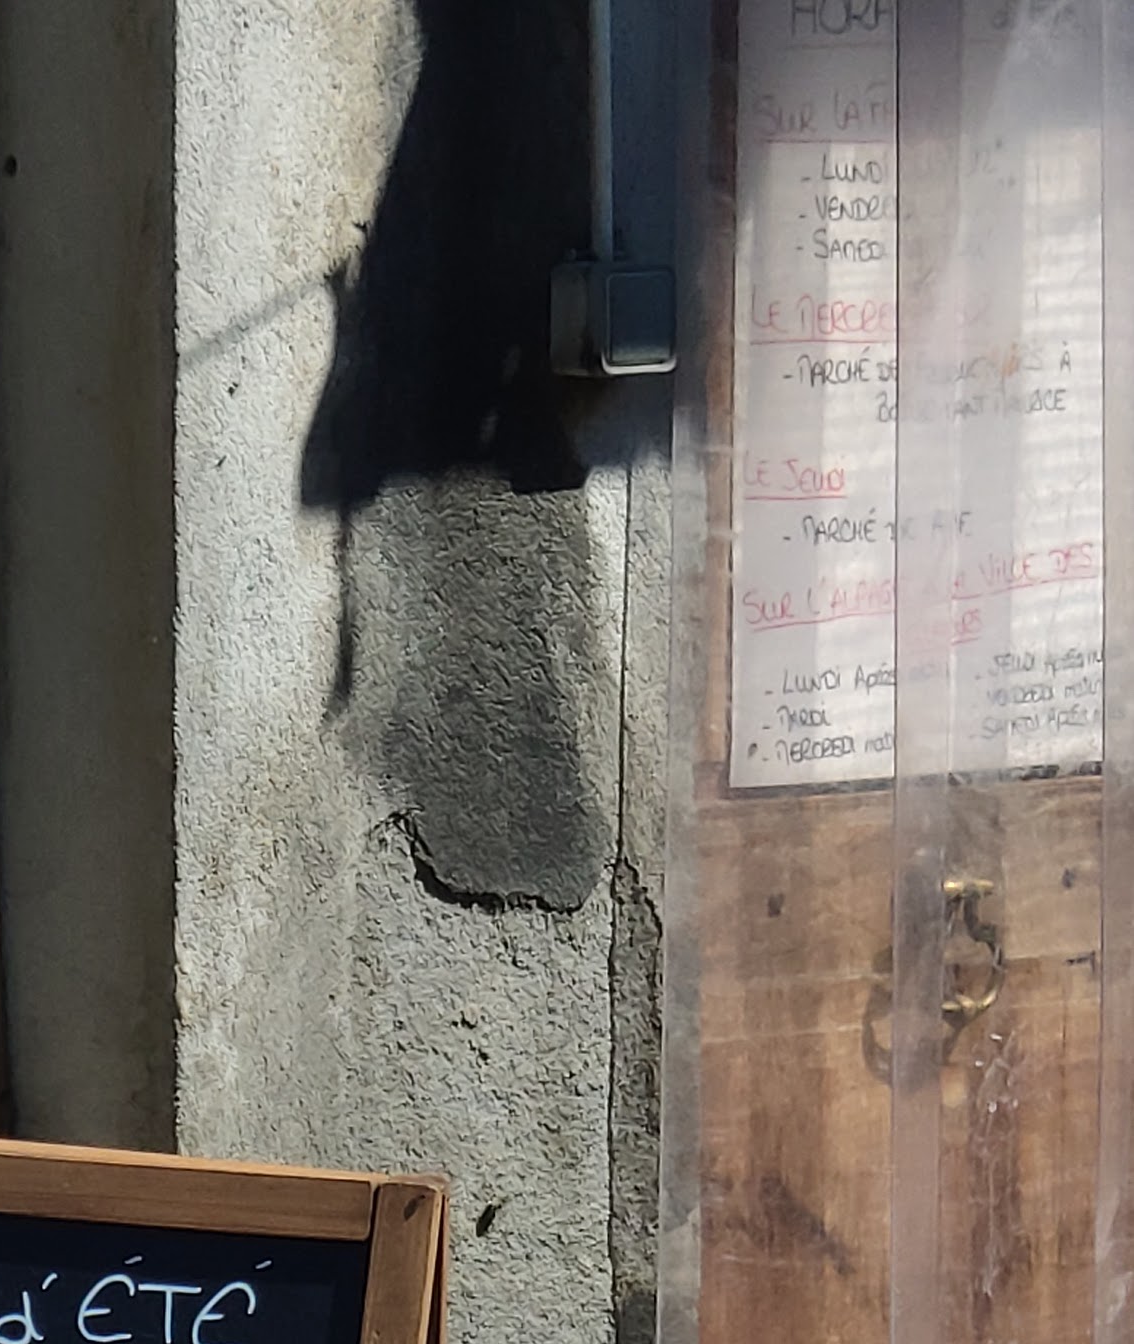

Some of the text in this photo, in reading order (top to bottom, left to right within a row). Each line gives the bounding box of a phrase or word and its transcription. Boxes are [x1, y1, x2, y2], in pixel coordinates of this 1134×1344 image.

[750, 290, 781, 330] LE
[743, 450, 847, 493] LE JEUDI
[741, 591, 793, 625] SUR
